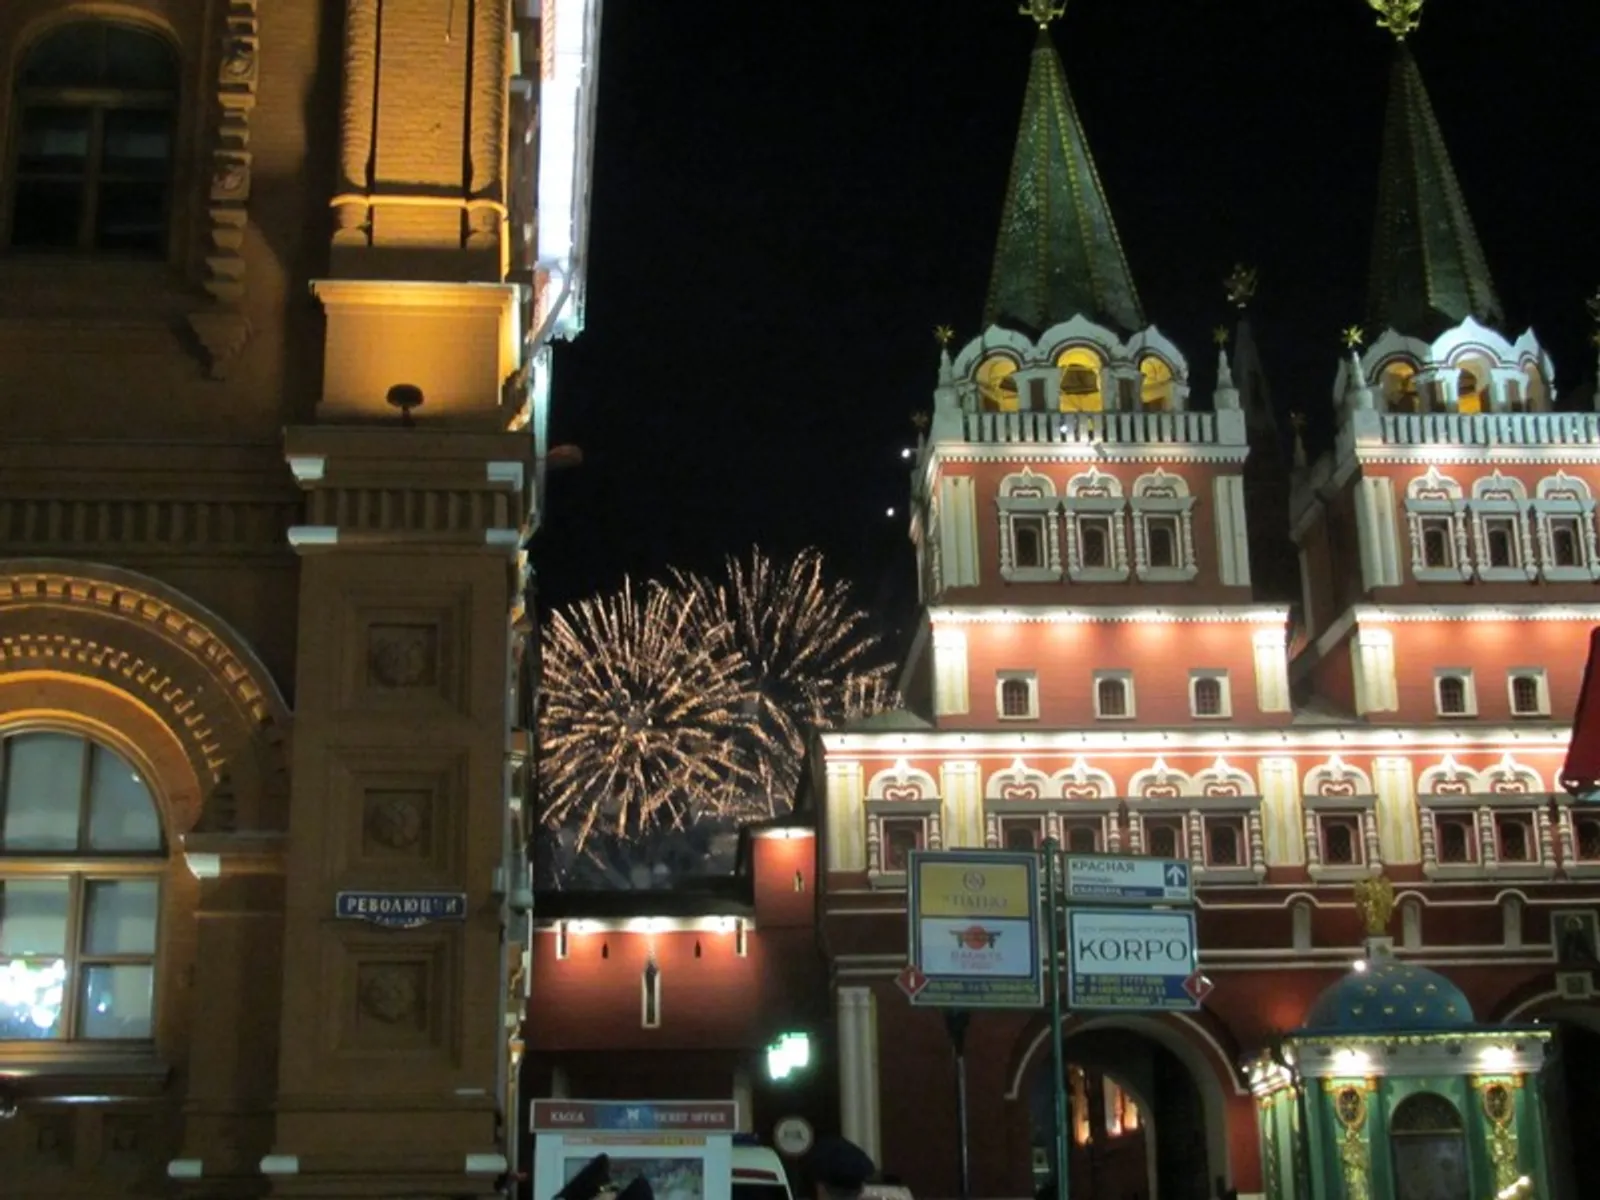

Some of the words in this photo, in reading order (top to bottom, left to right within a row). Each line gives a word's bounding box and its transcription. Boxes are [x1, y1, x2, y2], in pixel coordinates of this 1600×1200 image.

[1072, 860, 1136, 873] КРАСНАЯ
[1079, 937, 1188, 961] KORPO
[550, 1111, 586, 1123] КАССА
